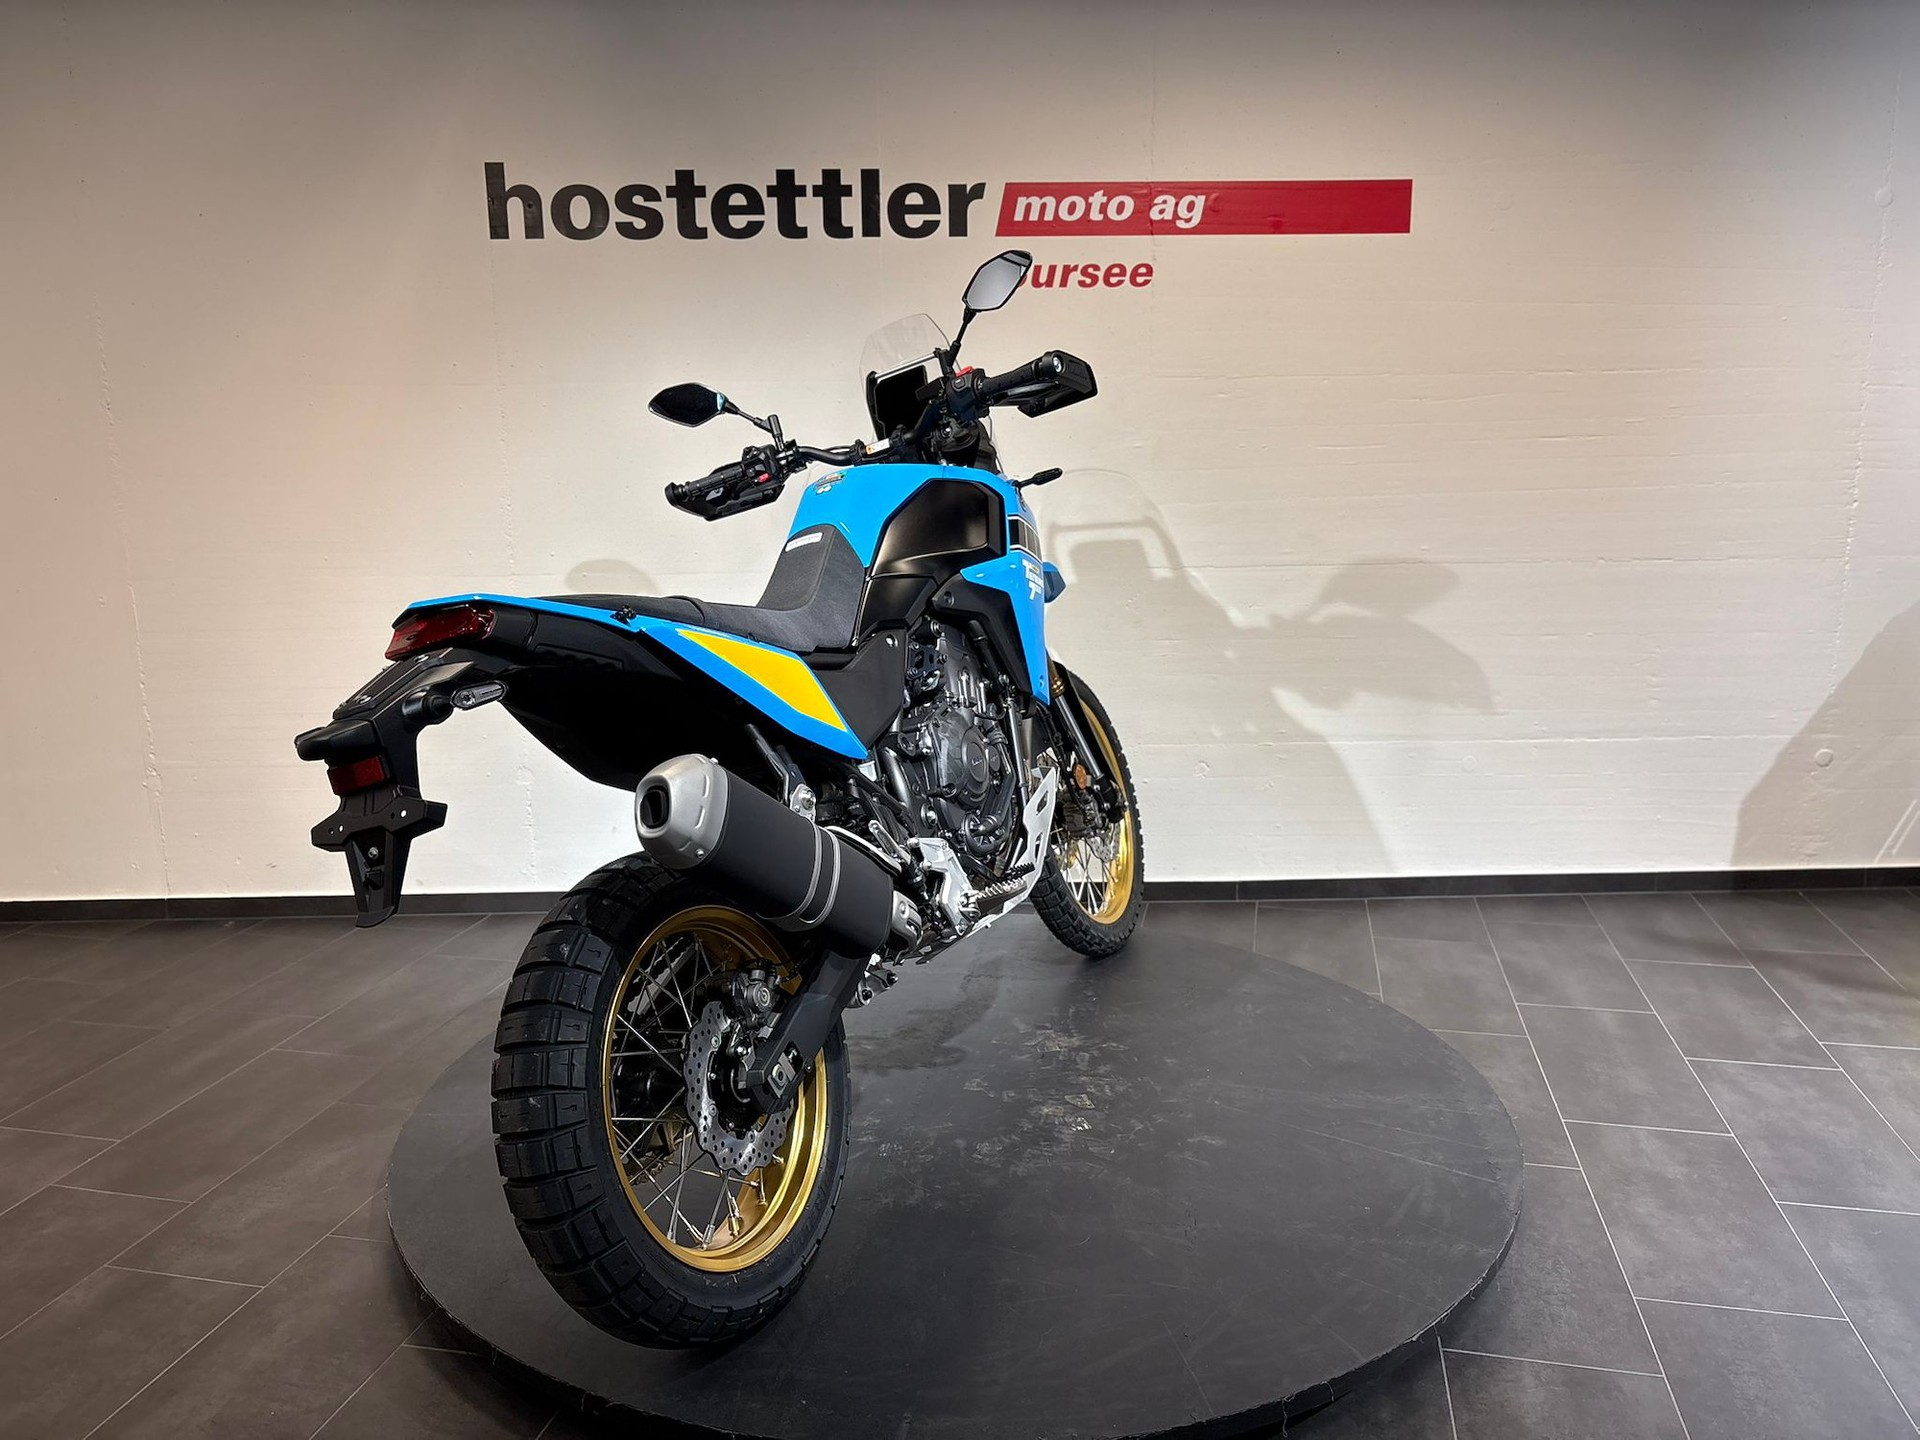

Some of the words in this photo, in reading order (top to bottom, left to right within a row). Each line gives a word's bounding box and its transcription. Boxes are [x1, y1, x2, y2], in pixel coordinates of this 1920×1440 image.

[485, 161, 987, 240] hostettler
[1013, 189, 1135, 222] moto
[1149, 194, 1207, 229] ag
[1018, 262, 1154, 289] ursee
